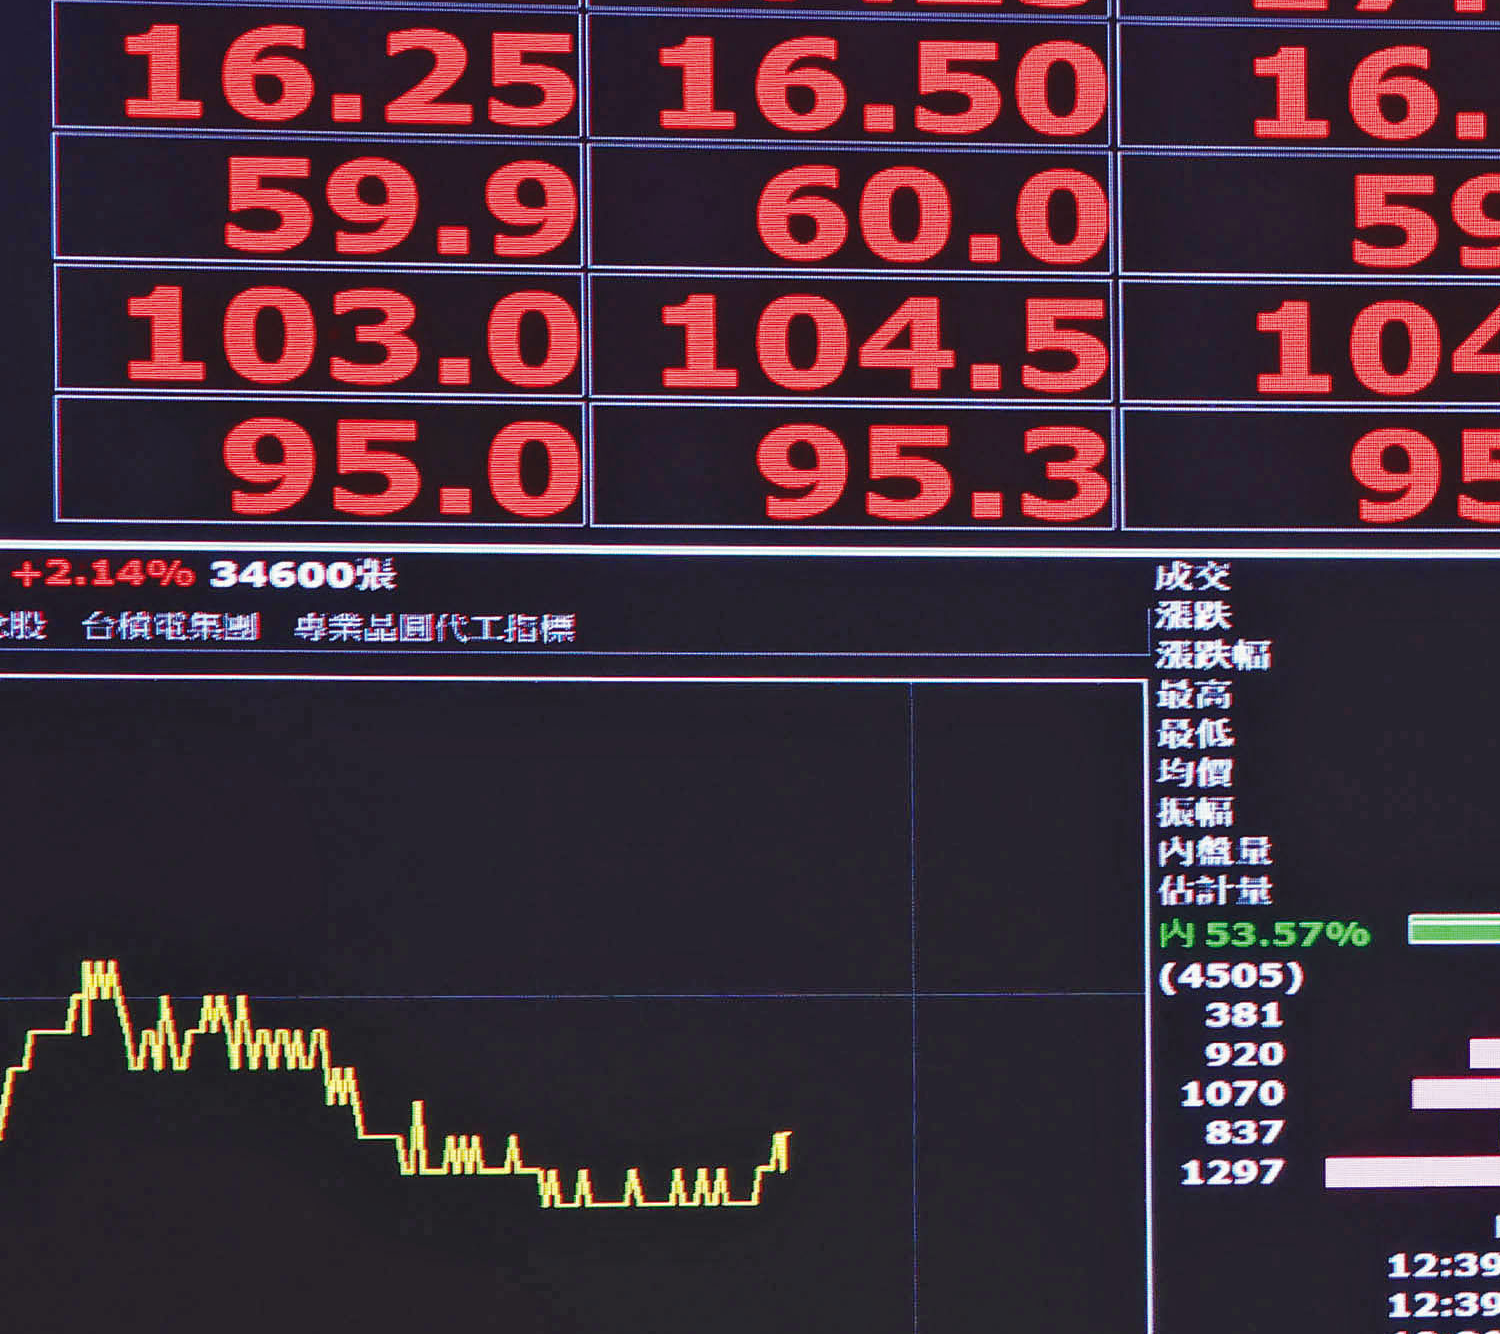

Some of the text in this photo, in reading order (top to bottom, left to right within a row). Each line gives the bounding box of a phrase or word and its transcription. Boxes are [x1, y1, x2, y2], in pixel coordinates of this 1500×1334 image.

[124, 23, 577, 127] 16.25
[658, 35, 1109, 137] 16.50
[222, 416, 582, 518] 95.0
[756, 423, 1111, 523] 95.3
[10, 558, 197, 588] +2.14%
[1153, 559, 1232, 592] 成交
[1153, 600, 1234, 632] 漲跌
[1155, 678, 1233, 710] 最高
[1155, 717, 1236, 750] 最低
[1154, 756, 1235, 789] 均價
[1155, 796, 1235, 828] 振幅
[1205, 920, 1372, 948] 53.57%
[1158, 960, 1305, 996] (4505)
